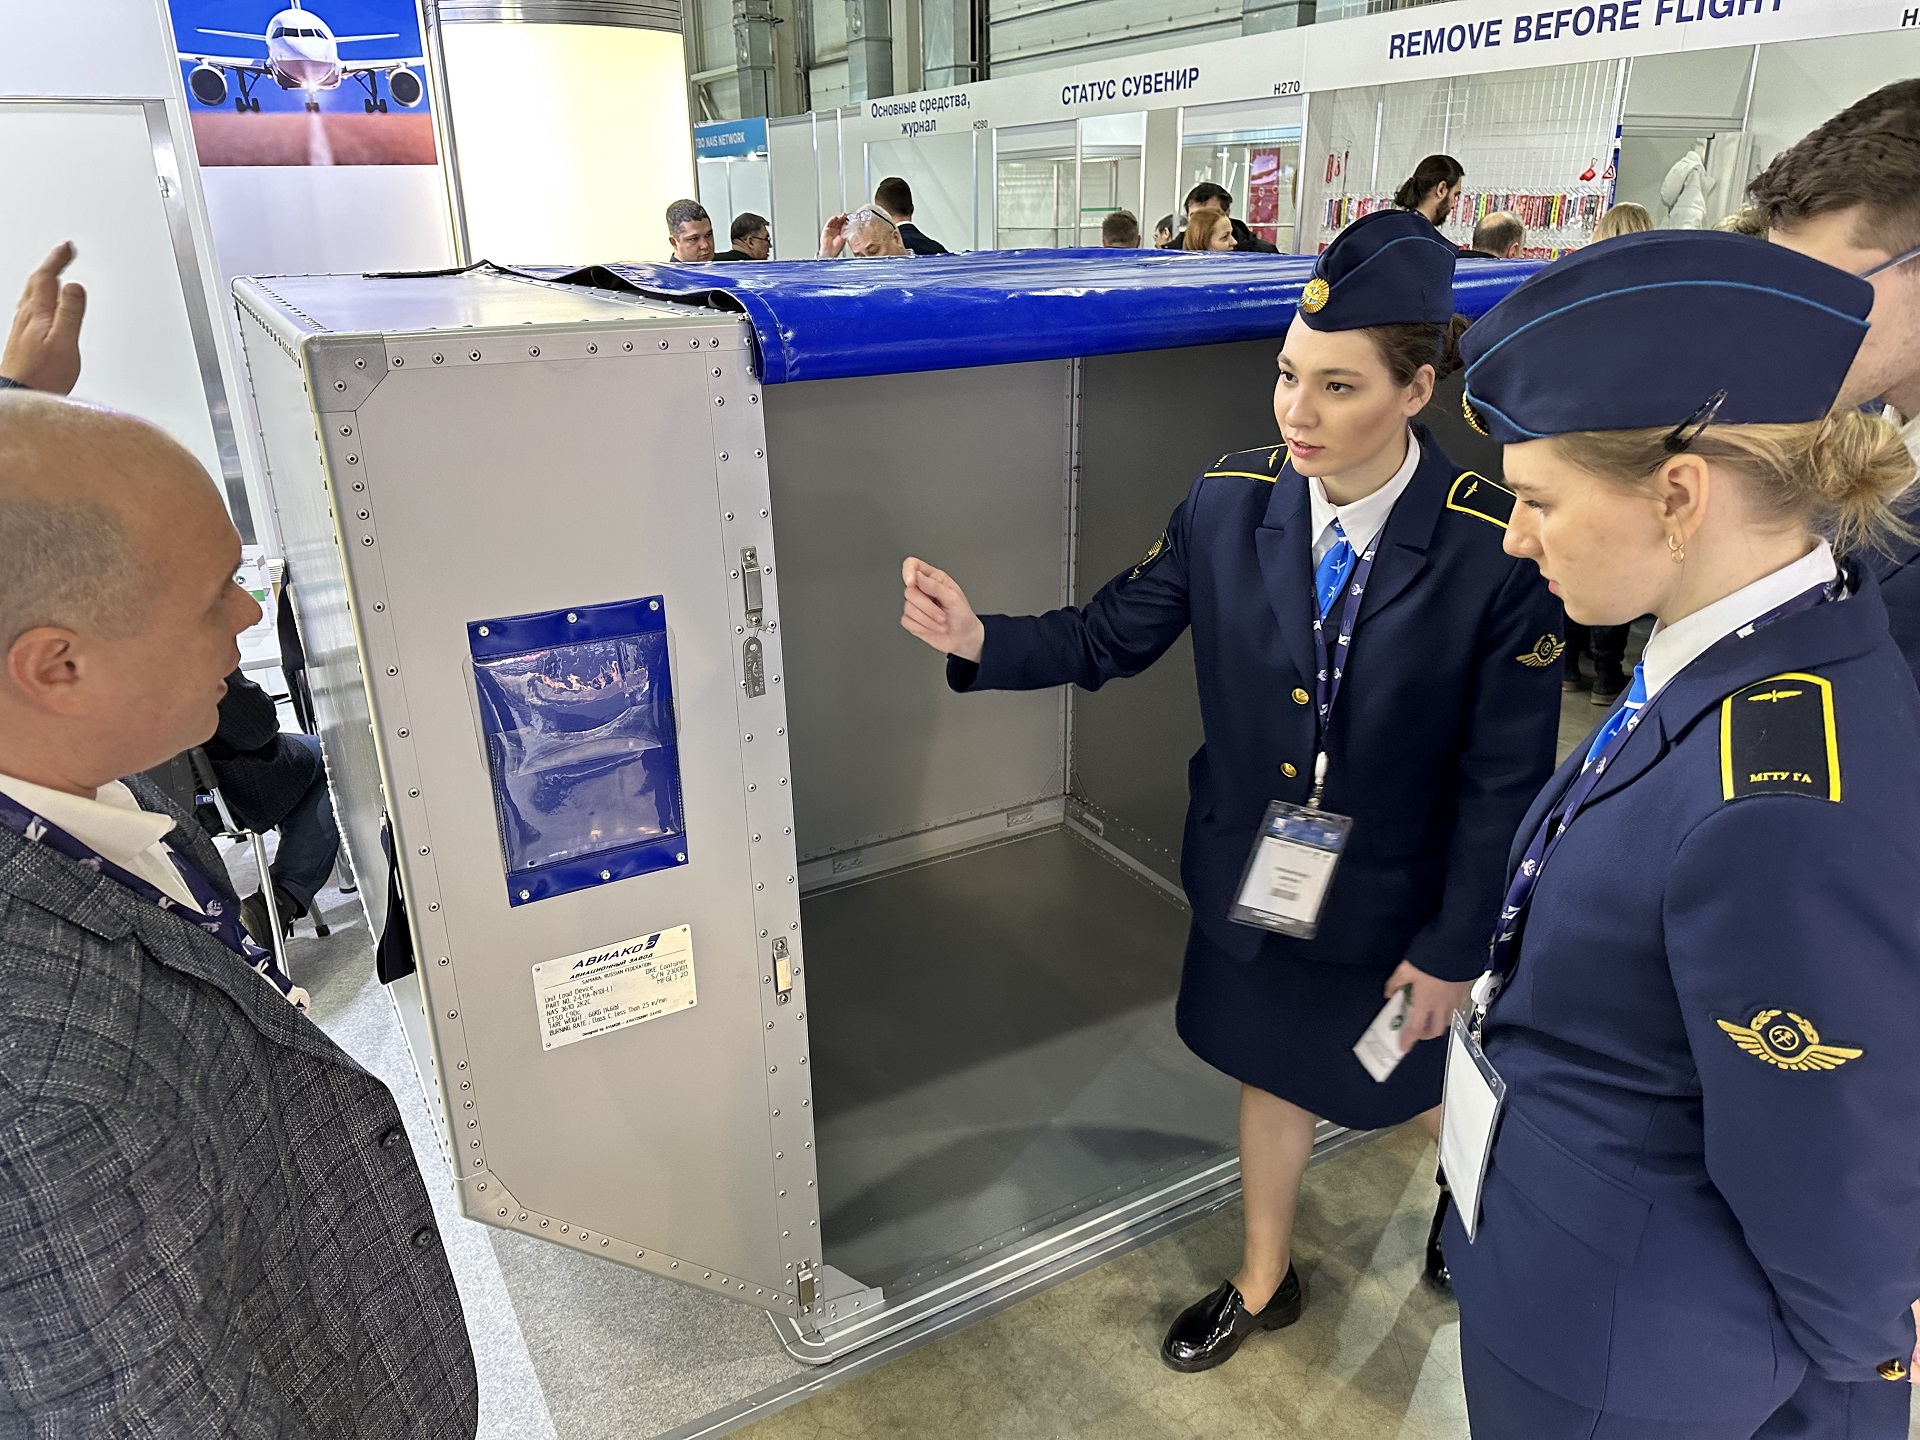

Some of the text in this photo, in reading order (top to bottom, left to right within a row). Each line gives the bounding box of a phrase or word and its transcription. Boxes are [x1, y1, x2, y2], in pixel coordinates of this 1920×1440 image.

[1389, 18, 1502, 60] REMOVE
[1513, 0, 1640, 44] BEFORE
[1062, 67, 1200, 105] СТАТУС СУВЕНИР
[871, 93, 971, 119] Основные средства,
[901, 119, 937, 138] журнал
[718, 131, 746, 146] NETWORK
[1749, 771, 1812, 784] МГТУ ГА
[569, 952, 653, 979] АВИАЦИОННЫЙ ЗАВОД
[603, 968, 623, 978] RUSSIAN
[624, 961, 651, 972] FEDERATION
[659, 959, 687, 970] Container
[544, 984, 593, 1003] Unit Load Device
[545, 1000, 559, 1009] PART
[546, 1007, 558, 1016] NAS
[547, 1013, 563, 1023] ETSO
[548, 1020, 561, 1029] TARE
[563, 1014, 581, 1024] WEIGHT
[549, 1024, 570, 1036] BURNING
[572, 1019, 586, 1029] RATE
[592, 1013, 605, 1023] Class
